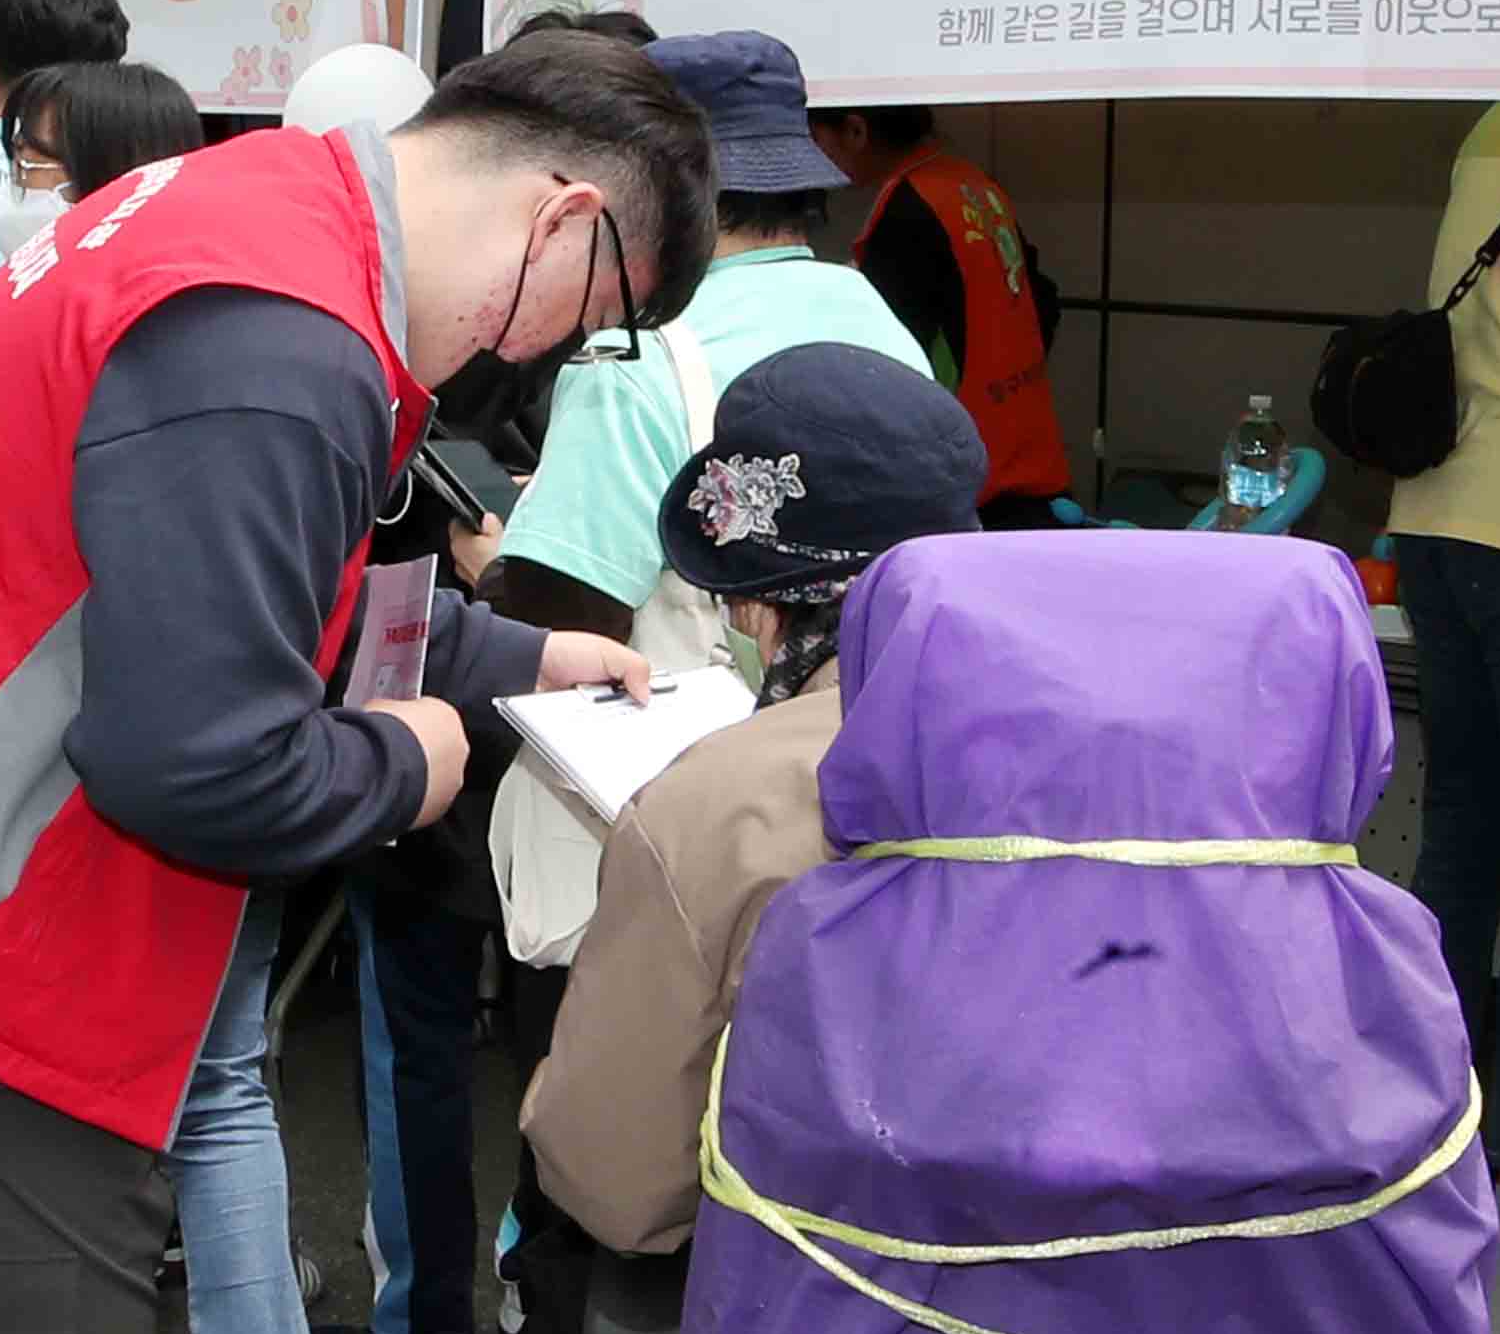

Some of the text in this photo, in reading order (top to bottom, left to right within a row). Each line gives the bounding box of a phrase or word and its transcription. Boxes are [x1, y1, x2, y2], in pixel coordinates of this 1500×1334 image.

[938, 7, 995, 47] 함께
[1002, 4, 1059, 43] 같은
[1067, 0, 1127, 41] 길을
